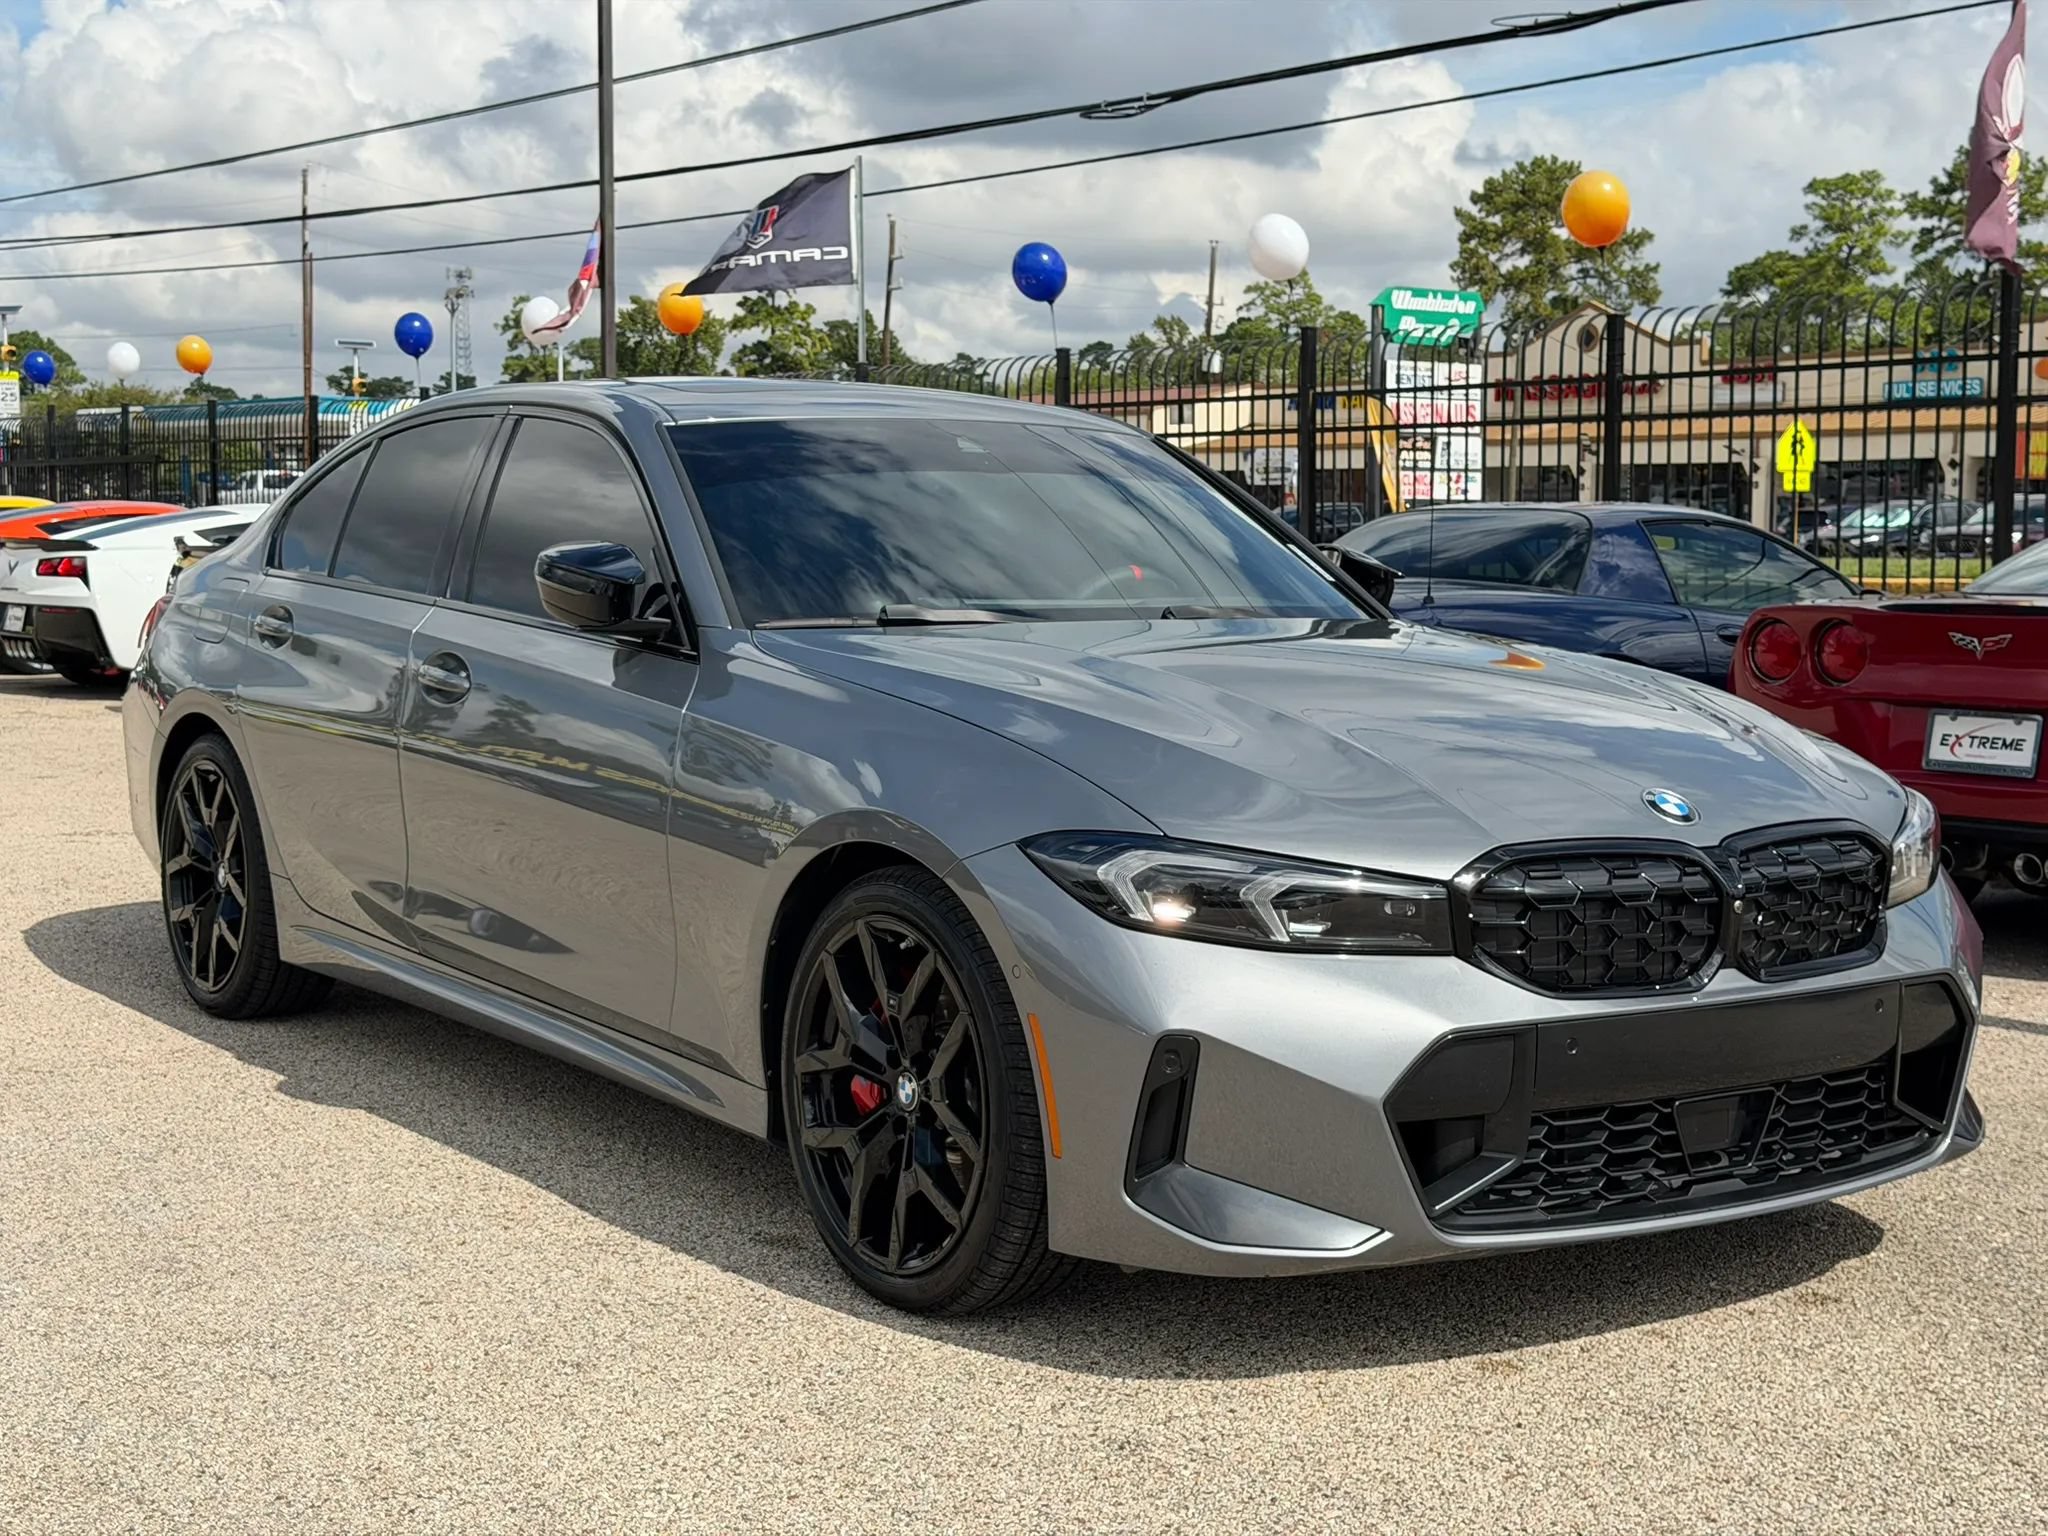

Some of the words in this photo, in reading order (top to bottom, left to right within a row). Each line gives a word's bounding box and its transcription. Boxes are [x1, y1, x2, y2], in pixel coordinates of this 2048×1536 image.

[1, 391, 17, 401] 25
[1494, 374, 1606, 402] MSSAG
[1939, 733, 2027, 752] EXTREME
